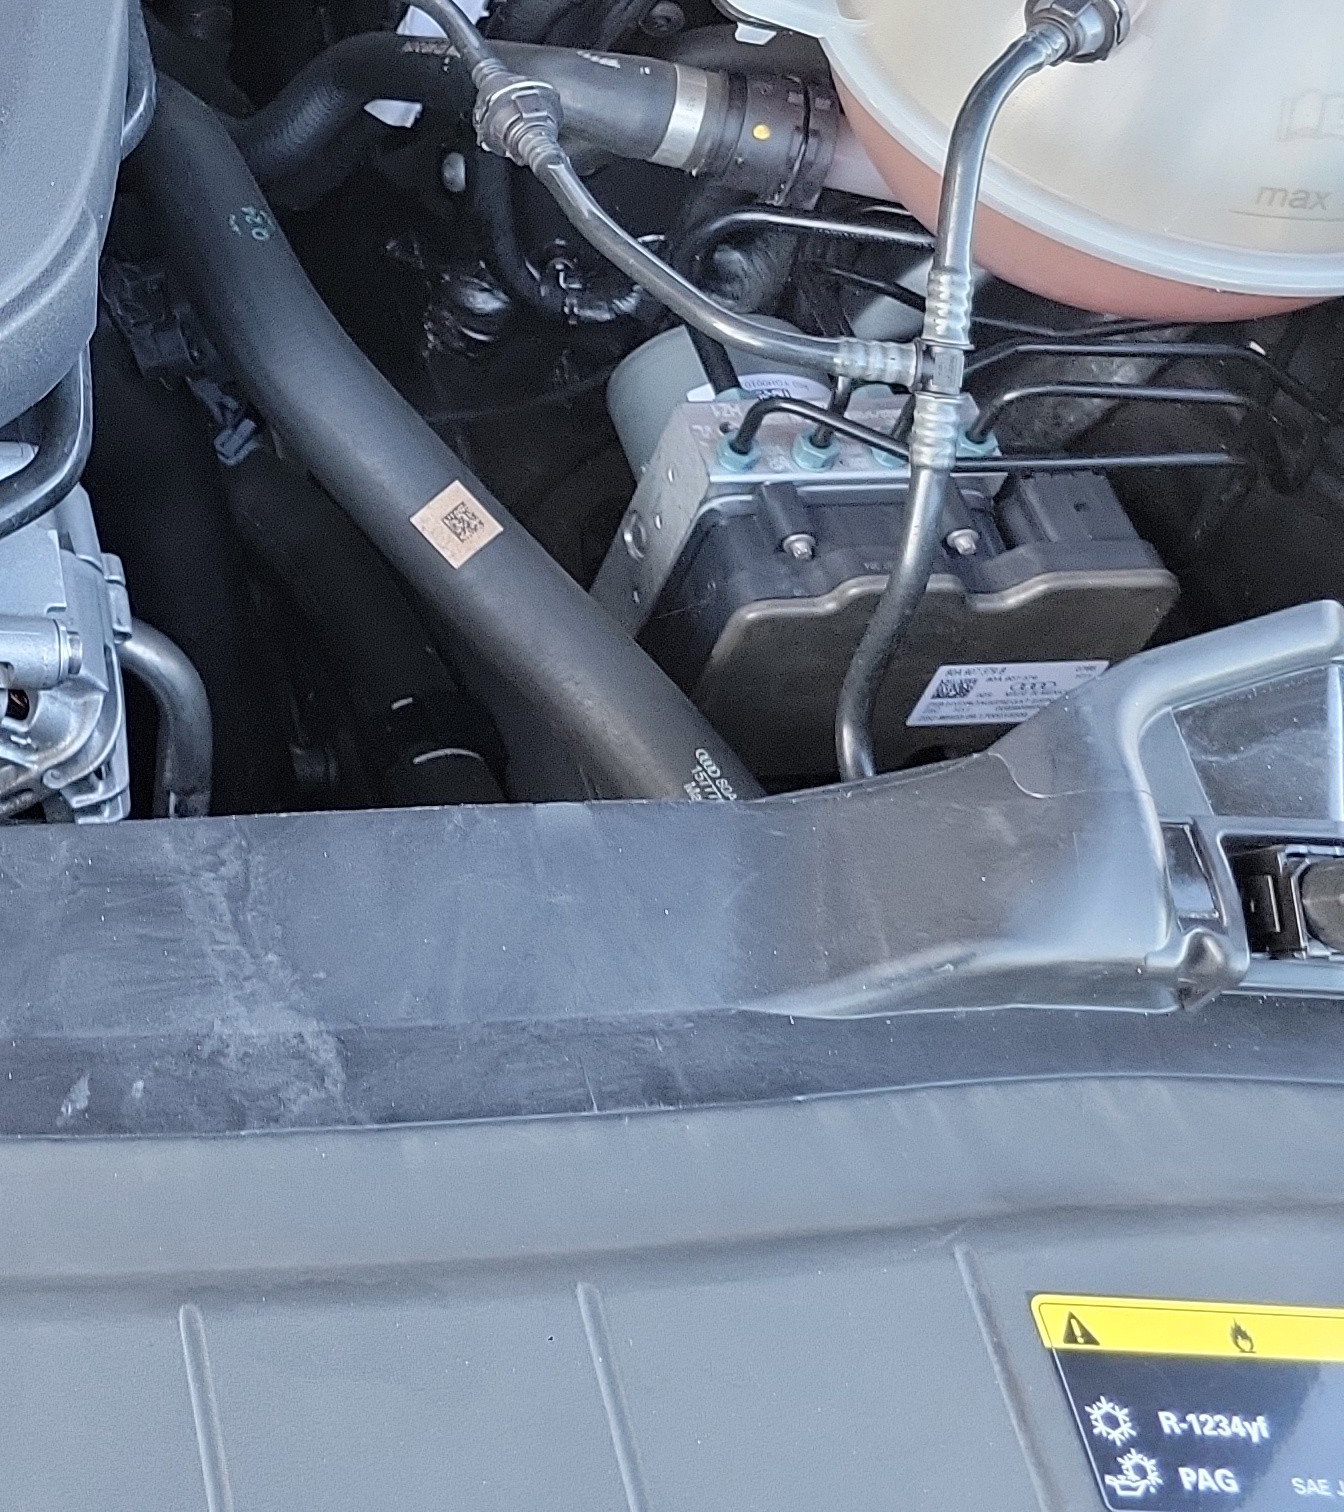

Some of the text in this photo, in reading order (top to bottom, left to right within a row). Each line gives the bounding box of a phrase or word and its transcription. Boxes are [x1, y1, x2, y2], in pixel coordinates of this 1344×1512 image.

[1256, 186, 1332, 211] max
[1158, 1410, 1271, 1444] R-1234yf
[1178, 1466, 1240, 1494] PAG
[1290, 1476, 1332, 1497] SAE
